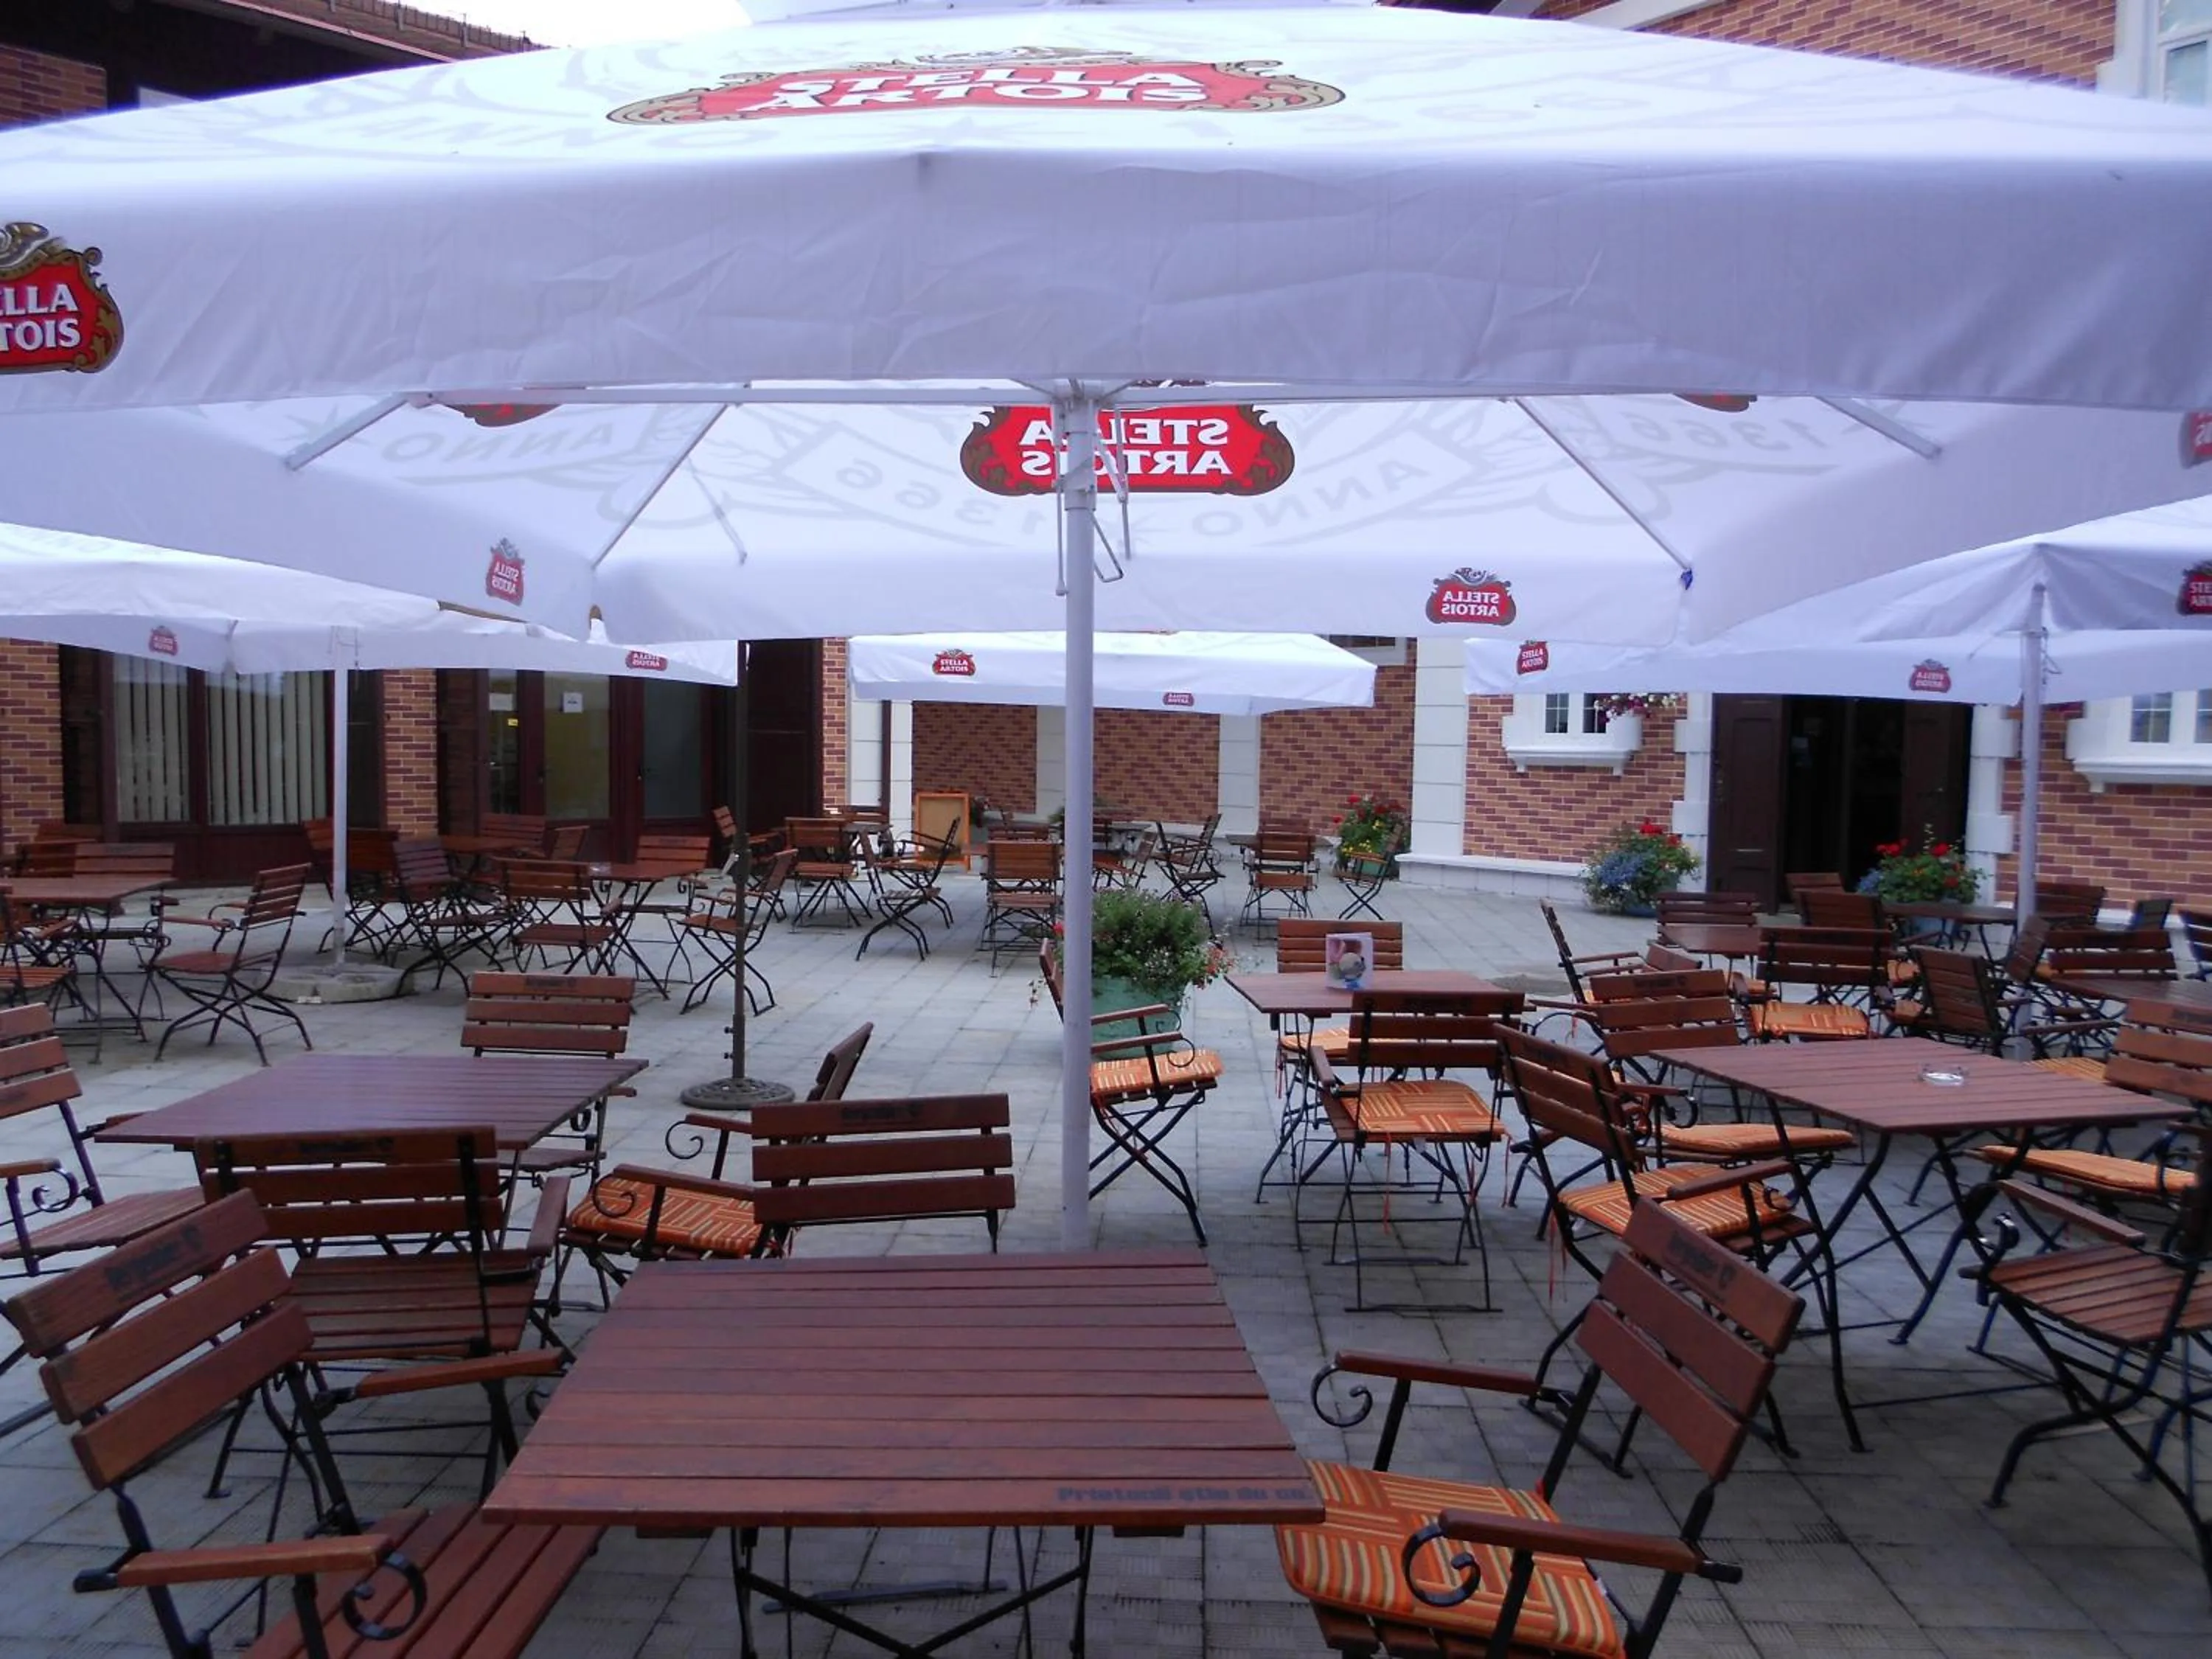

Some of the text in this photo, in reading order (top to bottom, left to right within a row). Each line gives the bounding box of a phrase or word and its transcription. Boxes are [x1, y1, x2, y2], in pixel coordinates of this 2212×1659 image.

[779, 69, 1205, 93] STELLA
[735, 83, 1208, 111] ARTOIS
[0, 283, 79, 316] LLA
